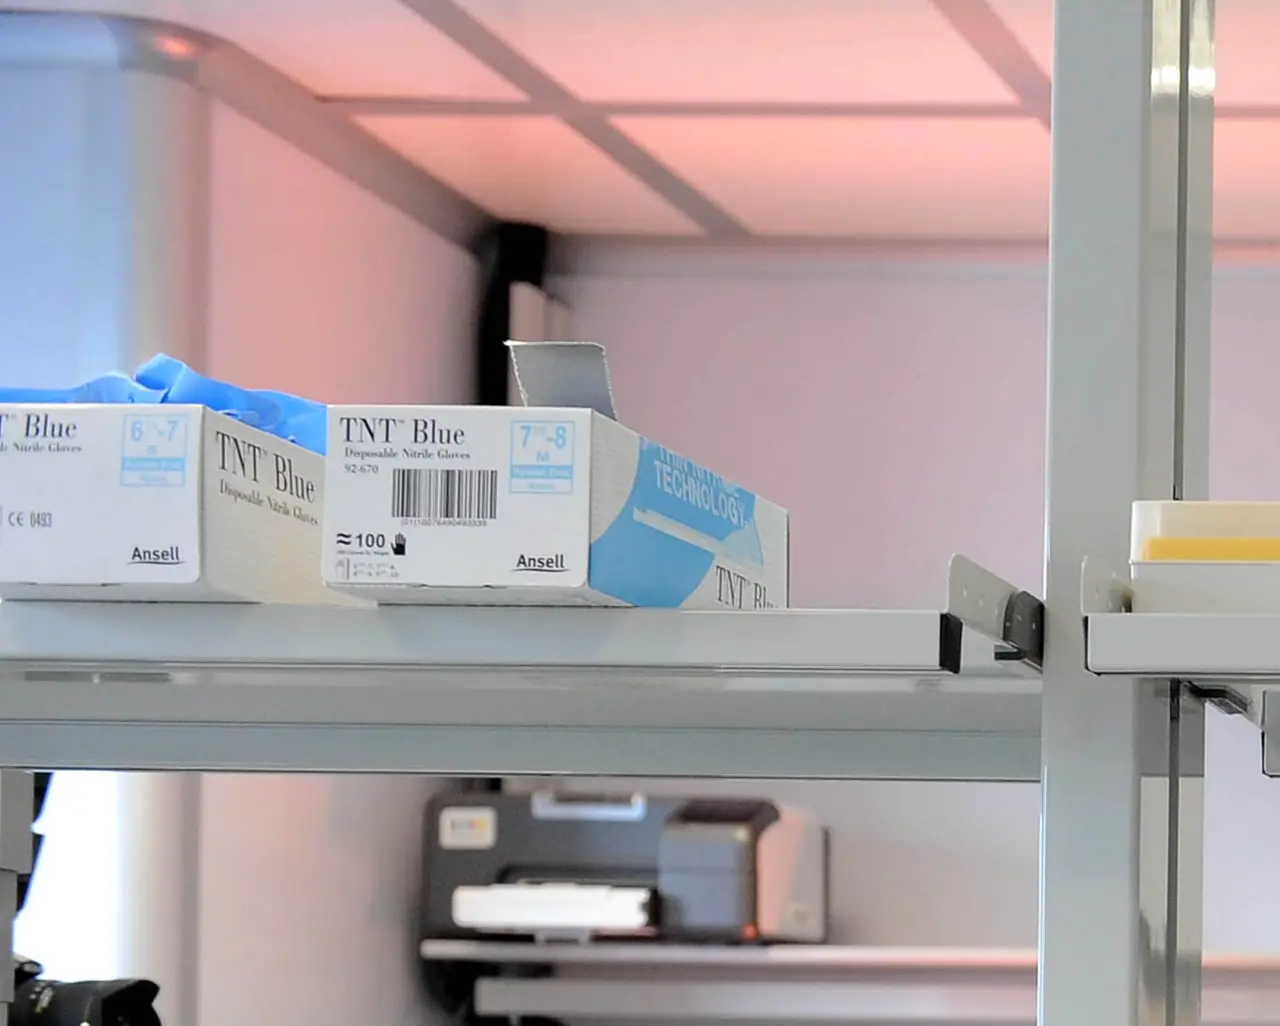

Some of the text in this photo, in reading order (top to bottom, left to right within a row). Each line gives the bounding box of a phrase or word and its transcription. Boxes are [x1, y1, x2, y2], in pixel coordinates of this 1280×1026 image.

[24, 413, 77, 438] Blue
[411, 418, 465, 445] Blue
[344, 447, 471, 460] Disposable Nitrile Gloves
[345, 464, 379, 474] 92-670
[273, 453, 315, 504] Blue
[30, 511, 52, 528] 0493
[355, 533, 386, 548] 100
[131, 546, 181, 562] Ansell
[516, 553, 565, 570] Ansell
